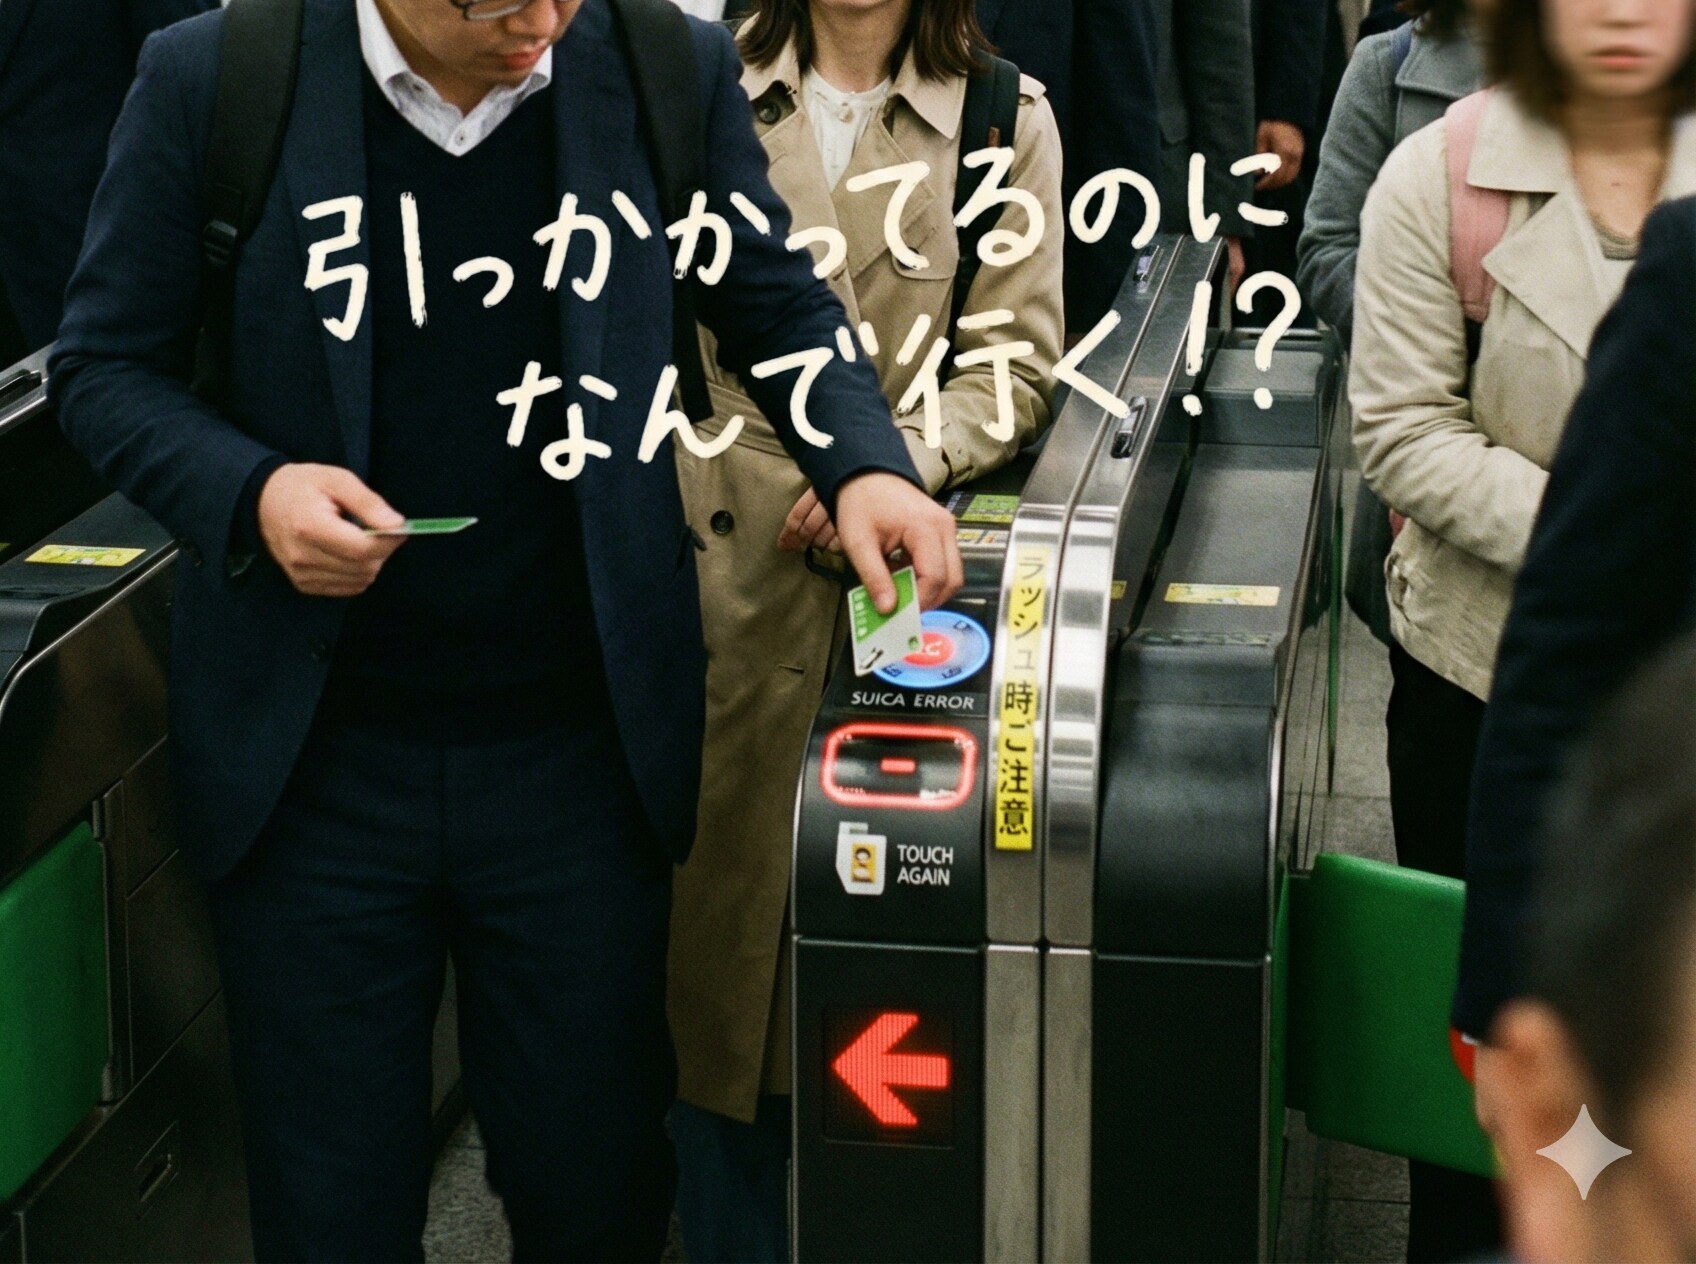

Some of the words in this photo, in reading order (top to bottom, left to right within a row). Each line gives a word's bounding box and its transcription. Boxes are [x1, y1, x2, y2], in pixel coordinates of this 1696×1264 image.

[850, 691, 906, 707] SUICA
[913, 693, 975, 710] ERROR
[1000, 557, 1044, 836] ラッシュ時ご注意
[897, 844, 954, 866] TOUCH
[896, 866, 950, 886] AGAIN
